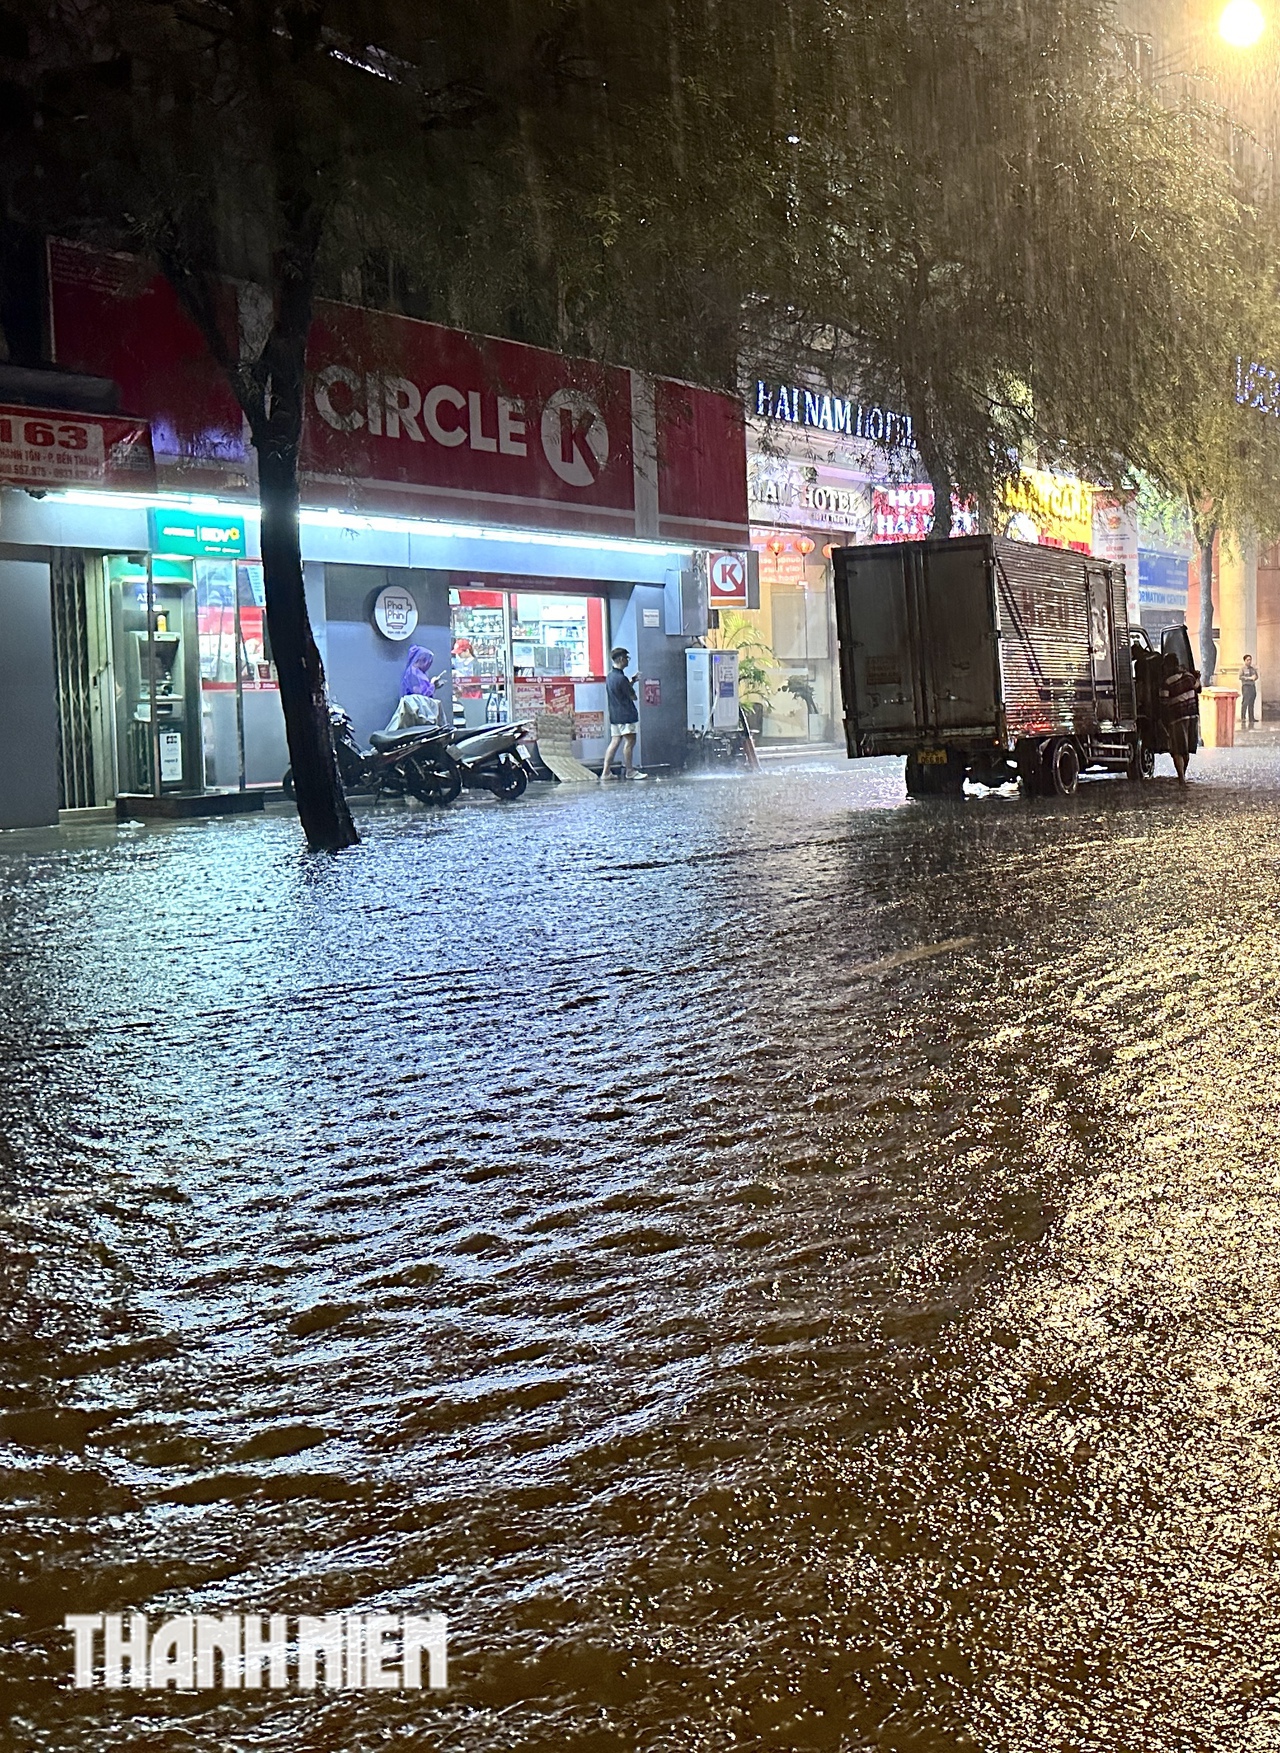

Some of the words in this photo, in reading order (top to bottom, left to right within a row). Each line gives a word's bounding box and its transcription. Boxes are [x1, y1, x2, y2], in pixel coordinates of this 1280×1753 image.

[804, 390, 852, 434] NAM
[313, 364, 527, 457] CIRCLE
[551, 396, 609, 487] K
[801, 485, 864, 514] HOTEL
[137, 593, 157, 602] AT
[1167, 593, 1187, 607] CENTER
[387, 600, 403, 610] Pha
[388, 609, 405, 620] Phin
